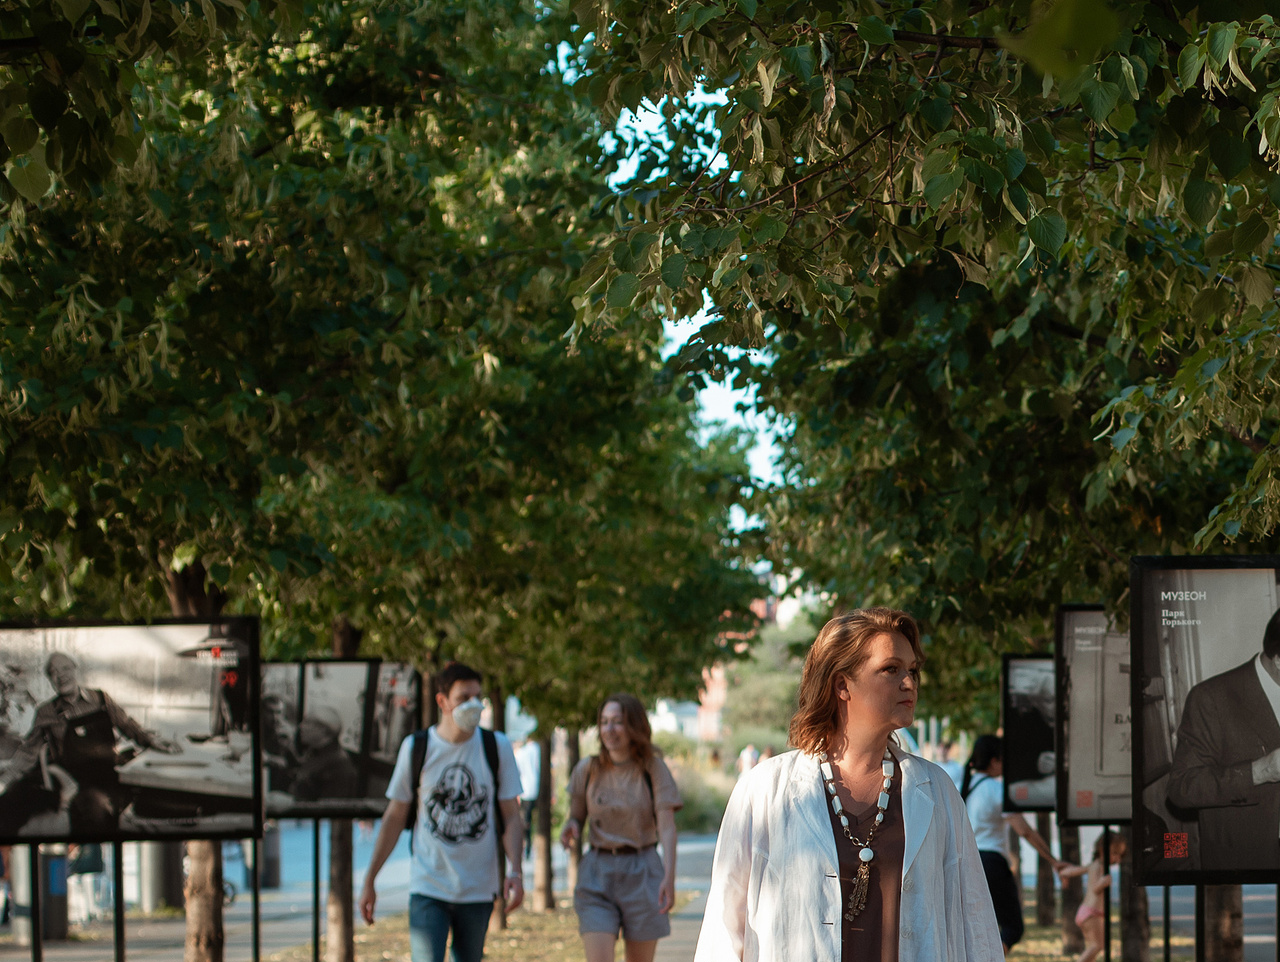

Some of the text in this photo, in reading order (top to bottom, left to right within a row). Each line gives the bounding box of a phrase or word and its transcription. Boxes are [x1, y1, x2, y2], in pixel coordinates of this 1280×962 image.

[1161, 591, 1206, 601] МУЗЕОН
[1161, 609, 1185, 619] Парк
[1161, 618, 1201, 628] Горького
